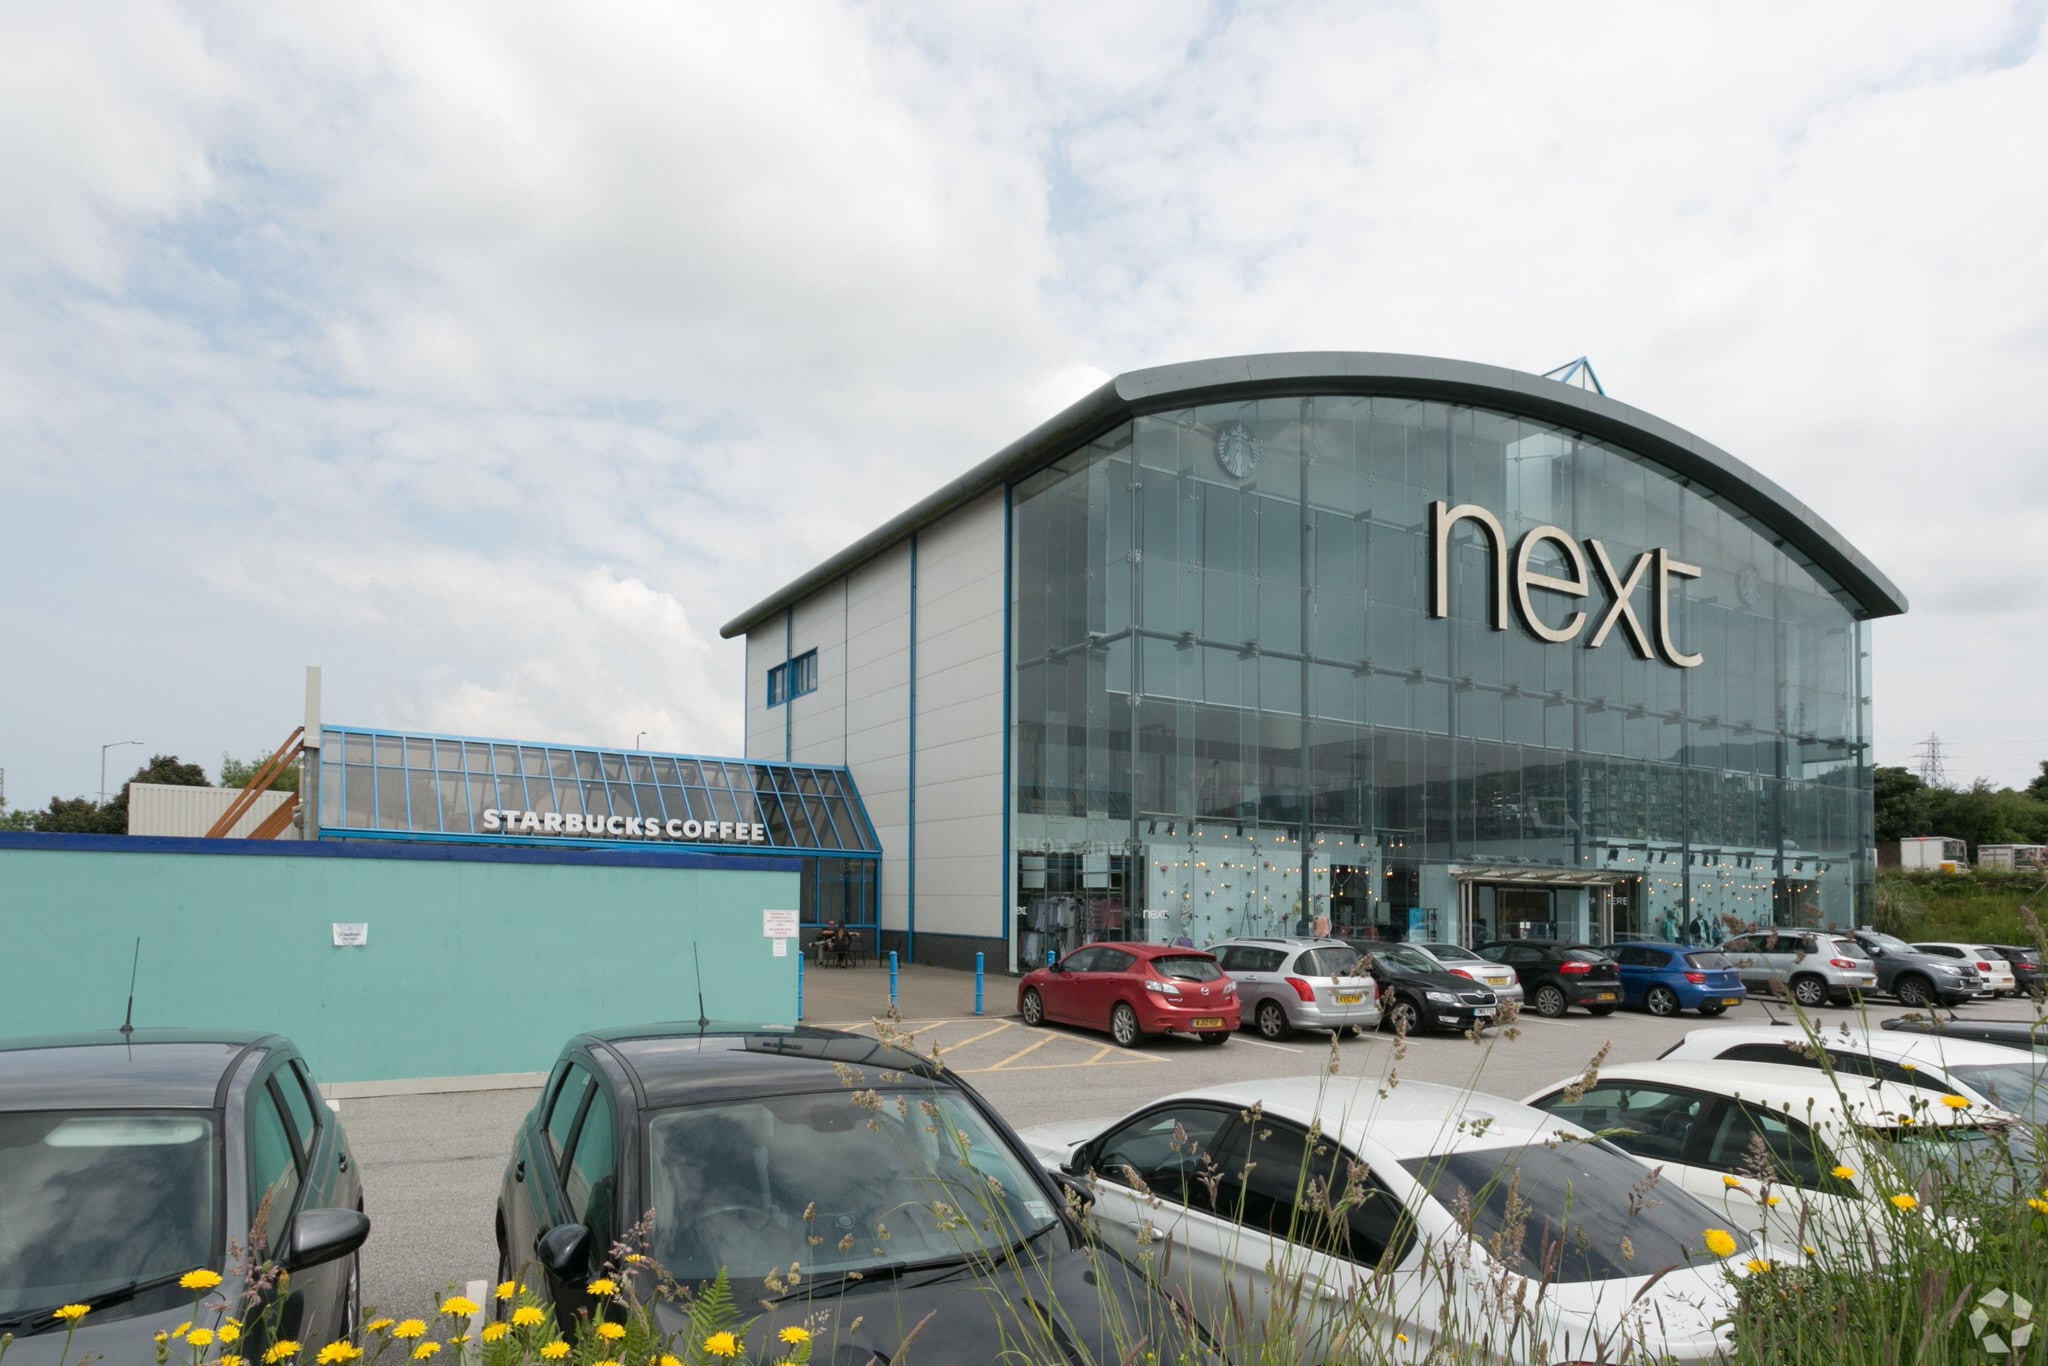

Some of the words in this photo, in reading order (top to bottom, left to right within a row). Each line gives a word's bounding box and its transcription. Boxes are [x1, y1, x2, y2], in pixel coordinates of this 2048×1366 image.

[1429, 500, 1704, 668] next
[483, 809, 660, 836] STARBUCKS
[665, 818, 765, 841] COFFEE
[1142, 909, 1168, 920] next
